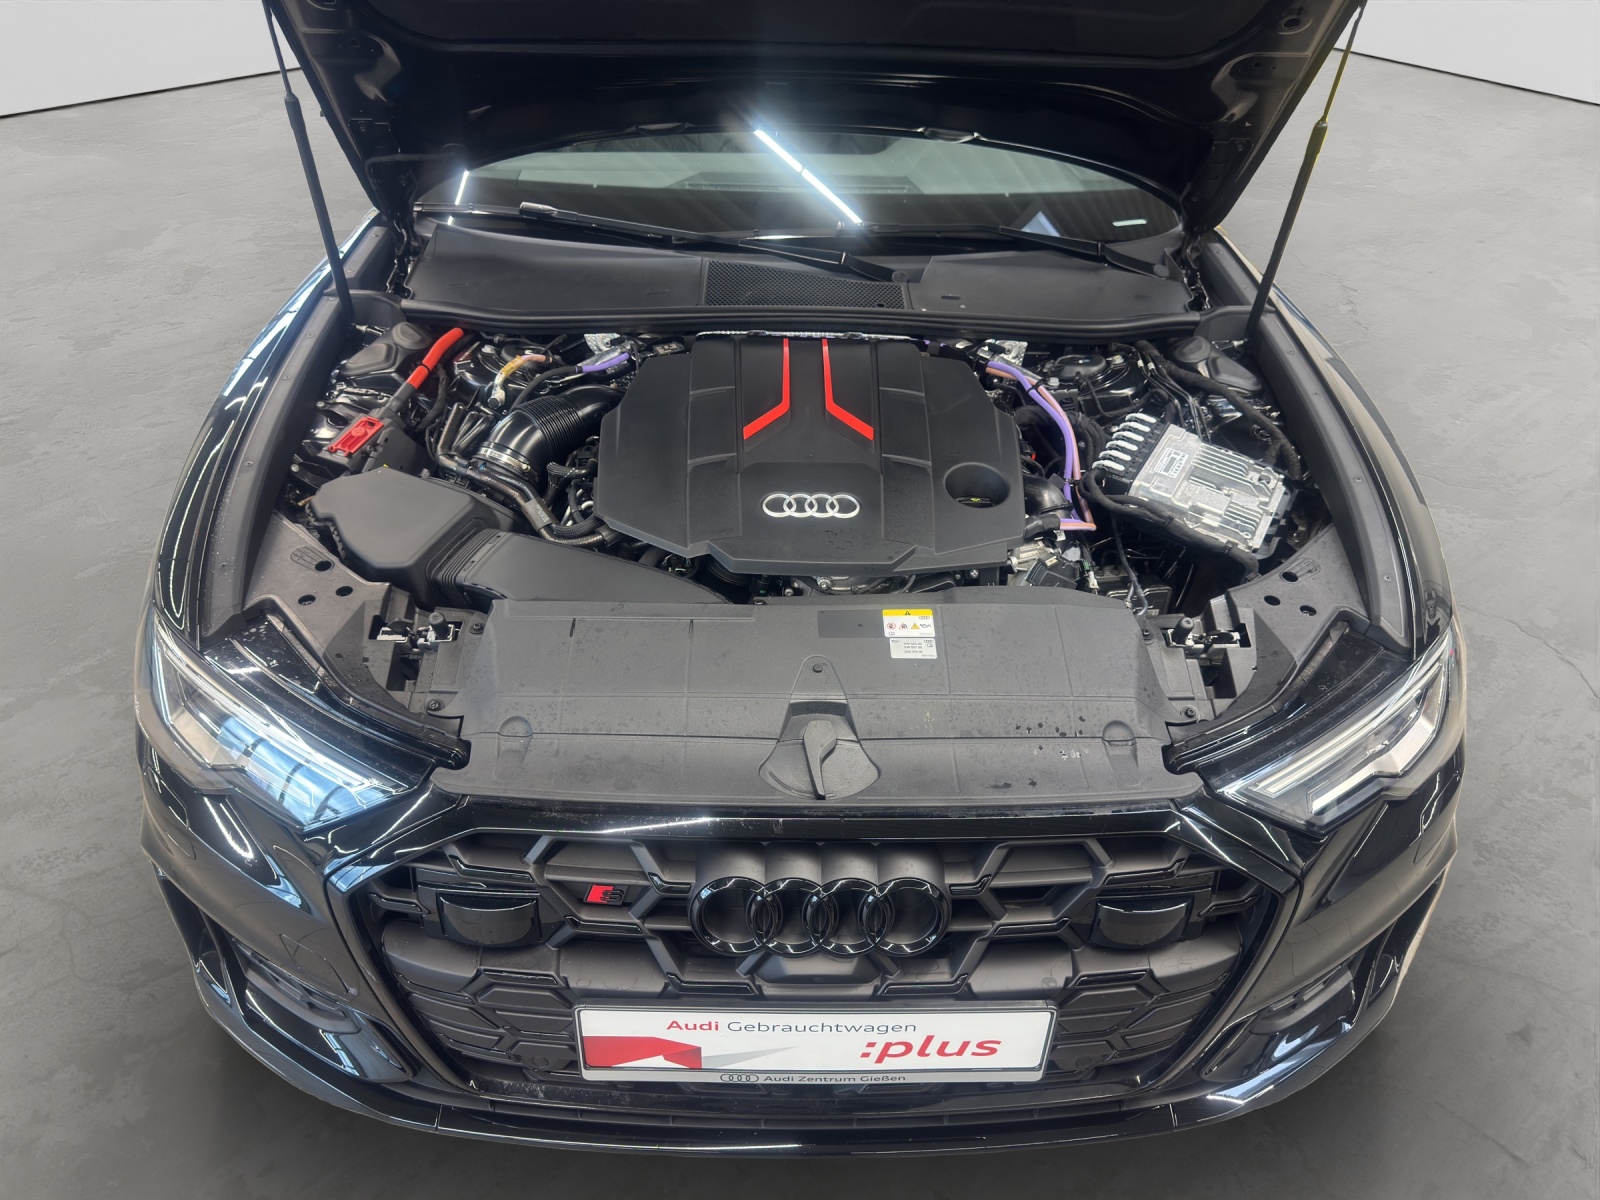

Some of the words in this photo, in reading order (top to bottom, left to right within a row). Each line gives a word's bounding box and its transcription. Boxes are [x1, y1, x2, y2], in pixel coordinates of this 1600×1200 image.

[666, 1020, 719, 1031] Audi
[727, 1021, 917, 1035] Gebrauchtwagen
[860, 1034, 1002, 1065] :plus
[798, 1075, 856, 1083] Zentrum
[860, 1075, 906, 1083] Gießen
